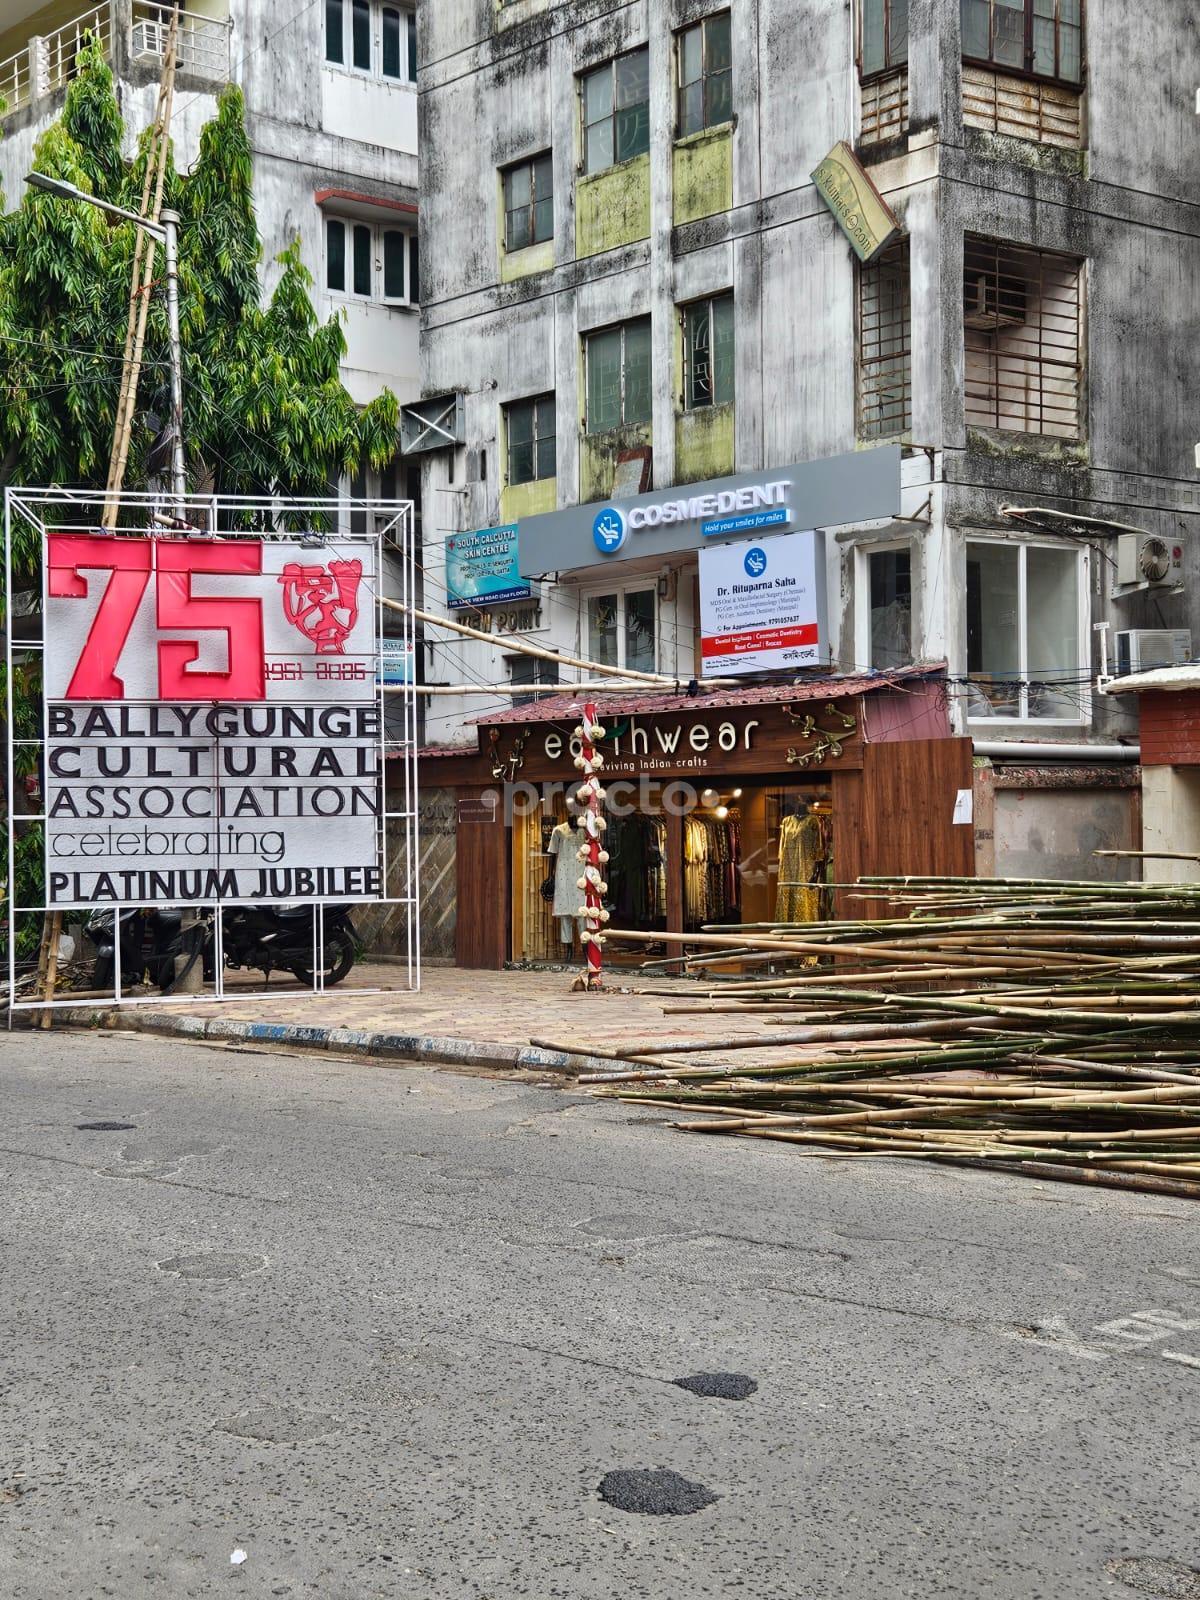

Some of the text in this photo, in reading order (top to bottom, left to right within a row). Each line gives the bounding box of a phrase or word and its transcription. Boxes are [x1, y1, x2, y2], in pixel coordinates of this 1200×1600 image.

[704, 513, 783, 533] Hold your smiles for miles
[457, 530, 516, 549] SOUTH CALCUTTA
[465, 543, 509, 559] SKIN CENTRE
[717, 577, 796, 597] Dr. Rituparna Saha
[47, 533, 266, 700] 75
[48, 705, 380, 738] BALLYGUNGE
[544, 716, 759, 760] eathwear
[48, 746, 380, 778] CULTURAL
[596, 756, 708, 771] eviving Indian crafts
[48, 786, 380, 818] ASSOCIATION
[52, 824, 286, 863] celebrating
[50, 866, 382, 902] PLATINUM JUBILEE
